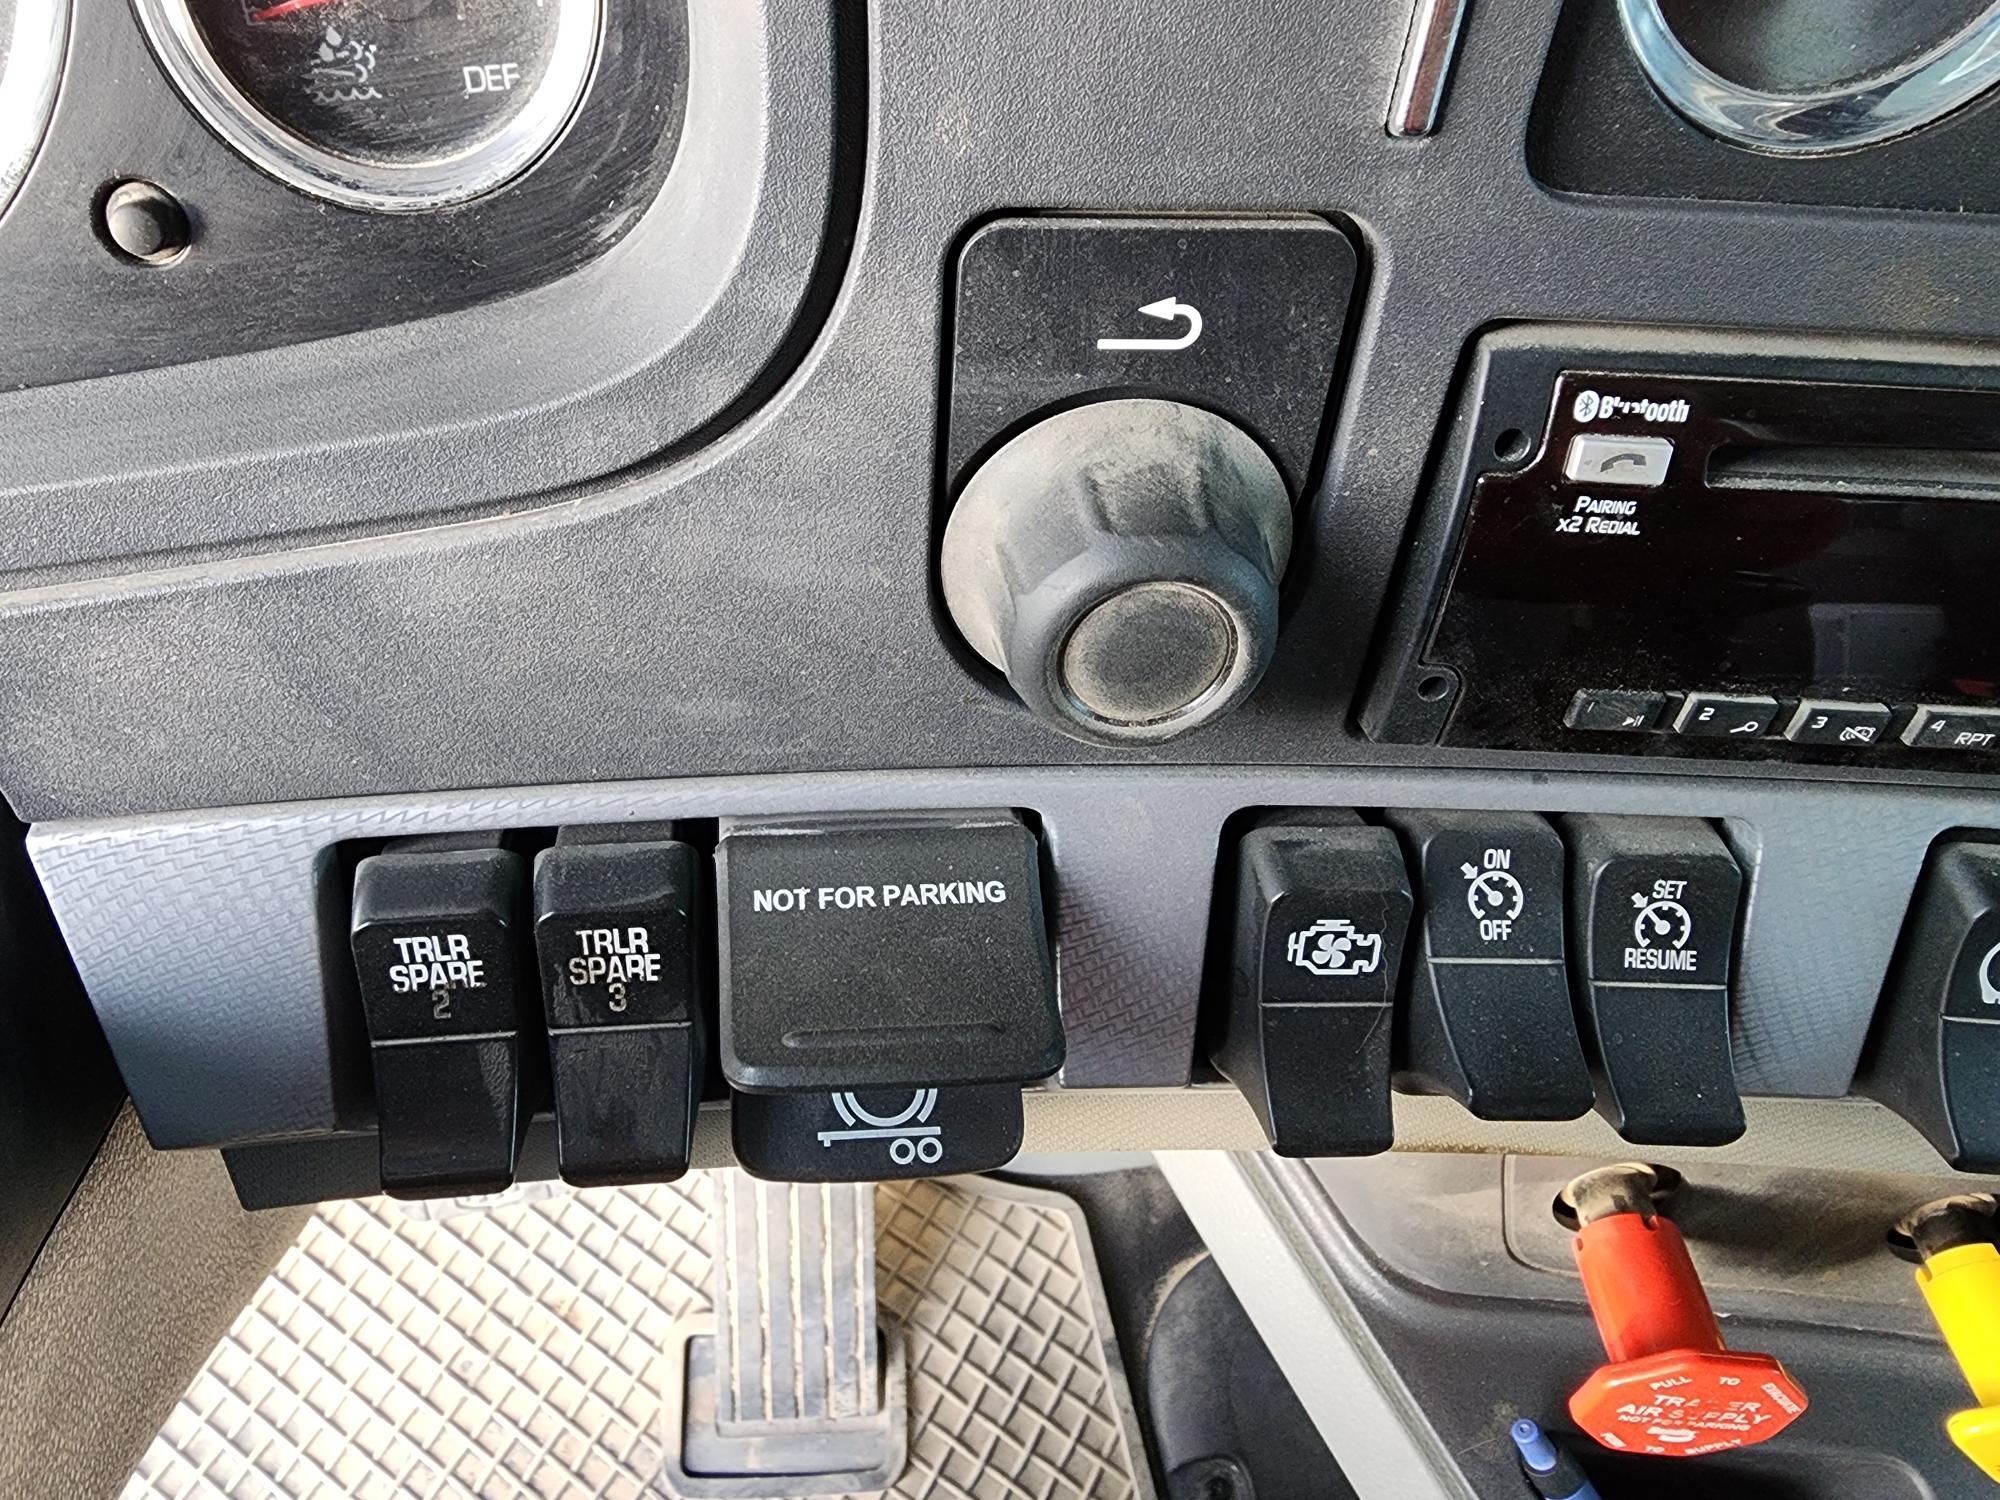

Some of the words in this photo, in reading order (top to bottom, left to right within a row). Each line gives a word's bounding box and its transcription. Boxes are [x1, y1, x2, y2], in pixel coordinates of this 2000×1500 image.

[463, 63, 521, 94] DEF
[1698, 707, 1716, 721] 2
[1811, 716, 1829, 729] 3
[1930, 719, 1947, 733] 4
[1954, 732, 1996, 747] RPT
[1483, 848, 1511, 870] ON
[753, 888, 811, 912] NOT
[818, 885, 877, 910] FOR
[882, 880, 1007, 907] PARKING
[1652, 880, 1688, 900] SET
[1480, 919, 1512, 941] OFF
[392, 933, 471, 964] TRLR
[576, 927, 650, 956] TRLR
[568, 953, 662, 986] SPARE
[1624, 948, 1698, 971] RESUME
[388, 959, 488, 993] SPARE
[431, 988, 452, 1020] 2
[608, 982, 628, 1013] 3
[1649, 1376, 1693, 1391] PULL
[1719, 1376, 1741, 1386] TO
[1616, 1403, 1664, 1417] AIR
[1668, 1409, 1773, 1425] SPPLY
[1617, 1414, 1651, 1424] NOT
